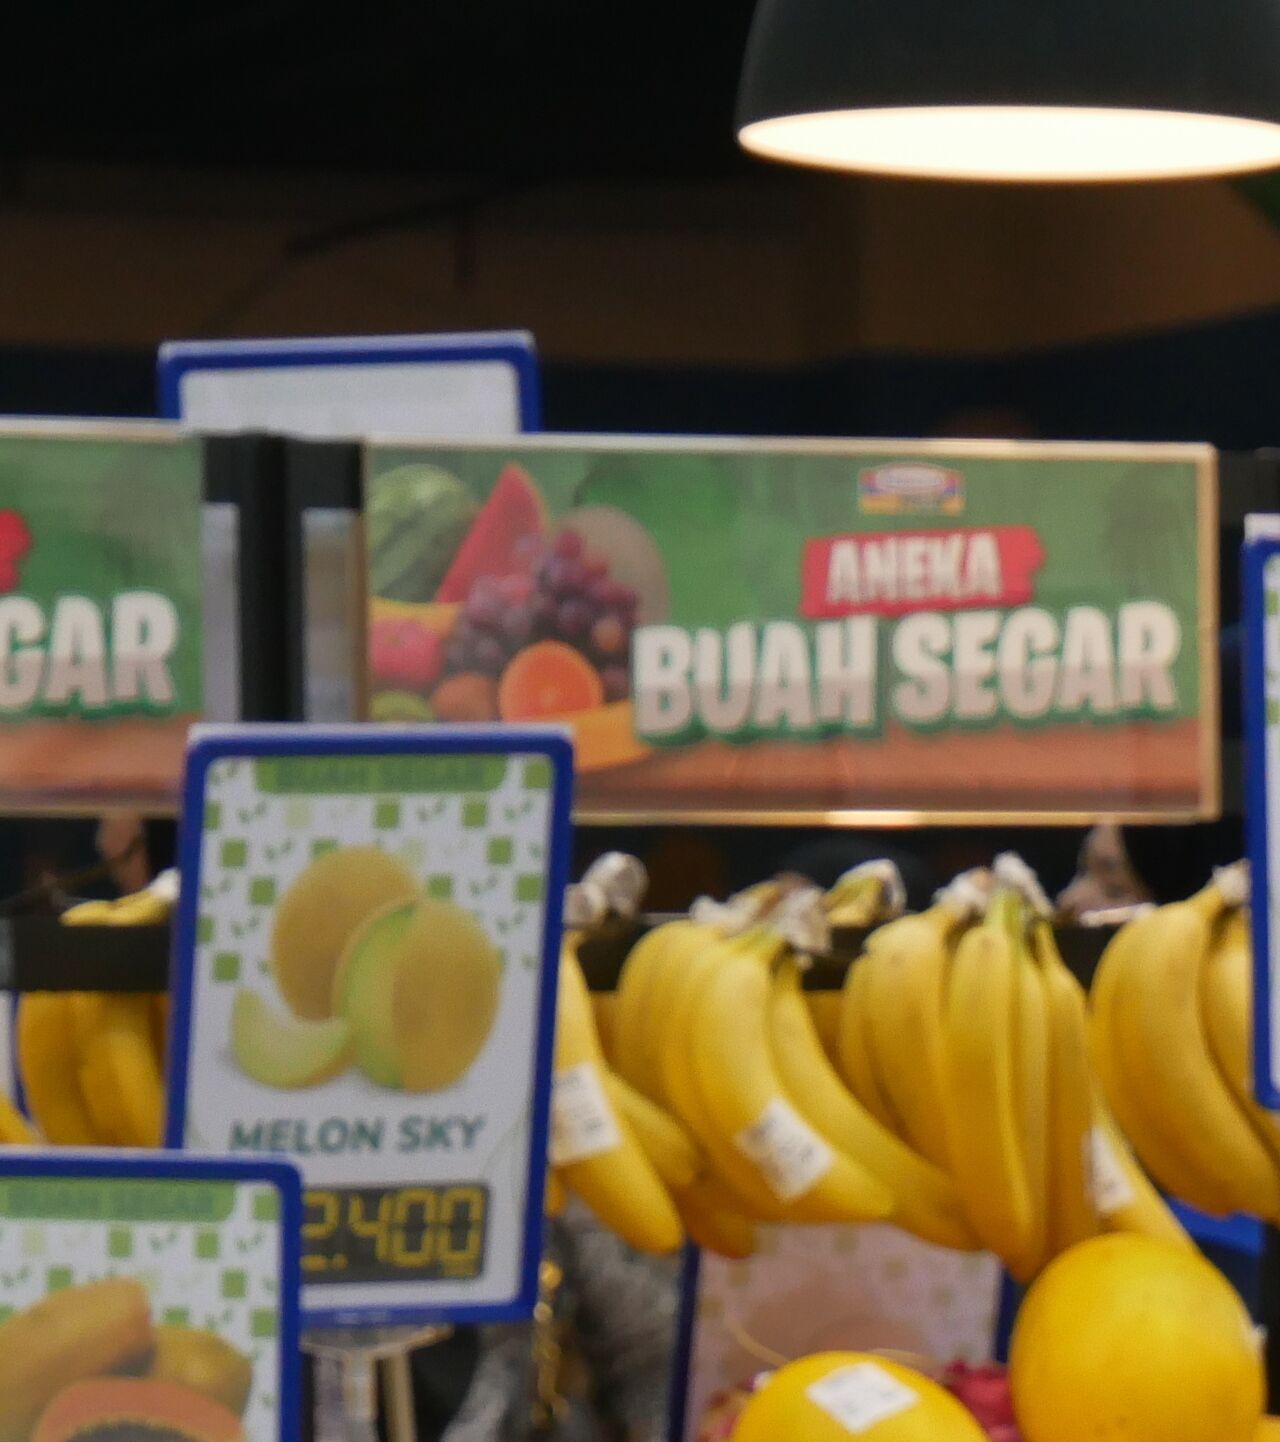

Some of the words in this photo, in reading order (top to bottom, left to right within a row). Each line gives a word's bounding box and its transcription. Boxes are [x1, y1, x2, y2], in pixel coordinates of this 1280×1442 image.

[826, 532, 1003, 602] ANEKA
[634, 616, 879, 736] BUAH
[891, 600, 1182, 720] SEGAR
[231, 1117, 385, 1153] MELON
[398, 1113, 486, 1151] SKY
